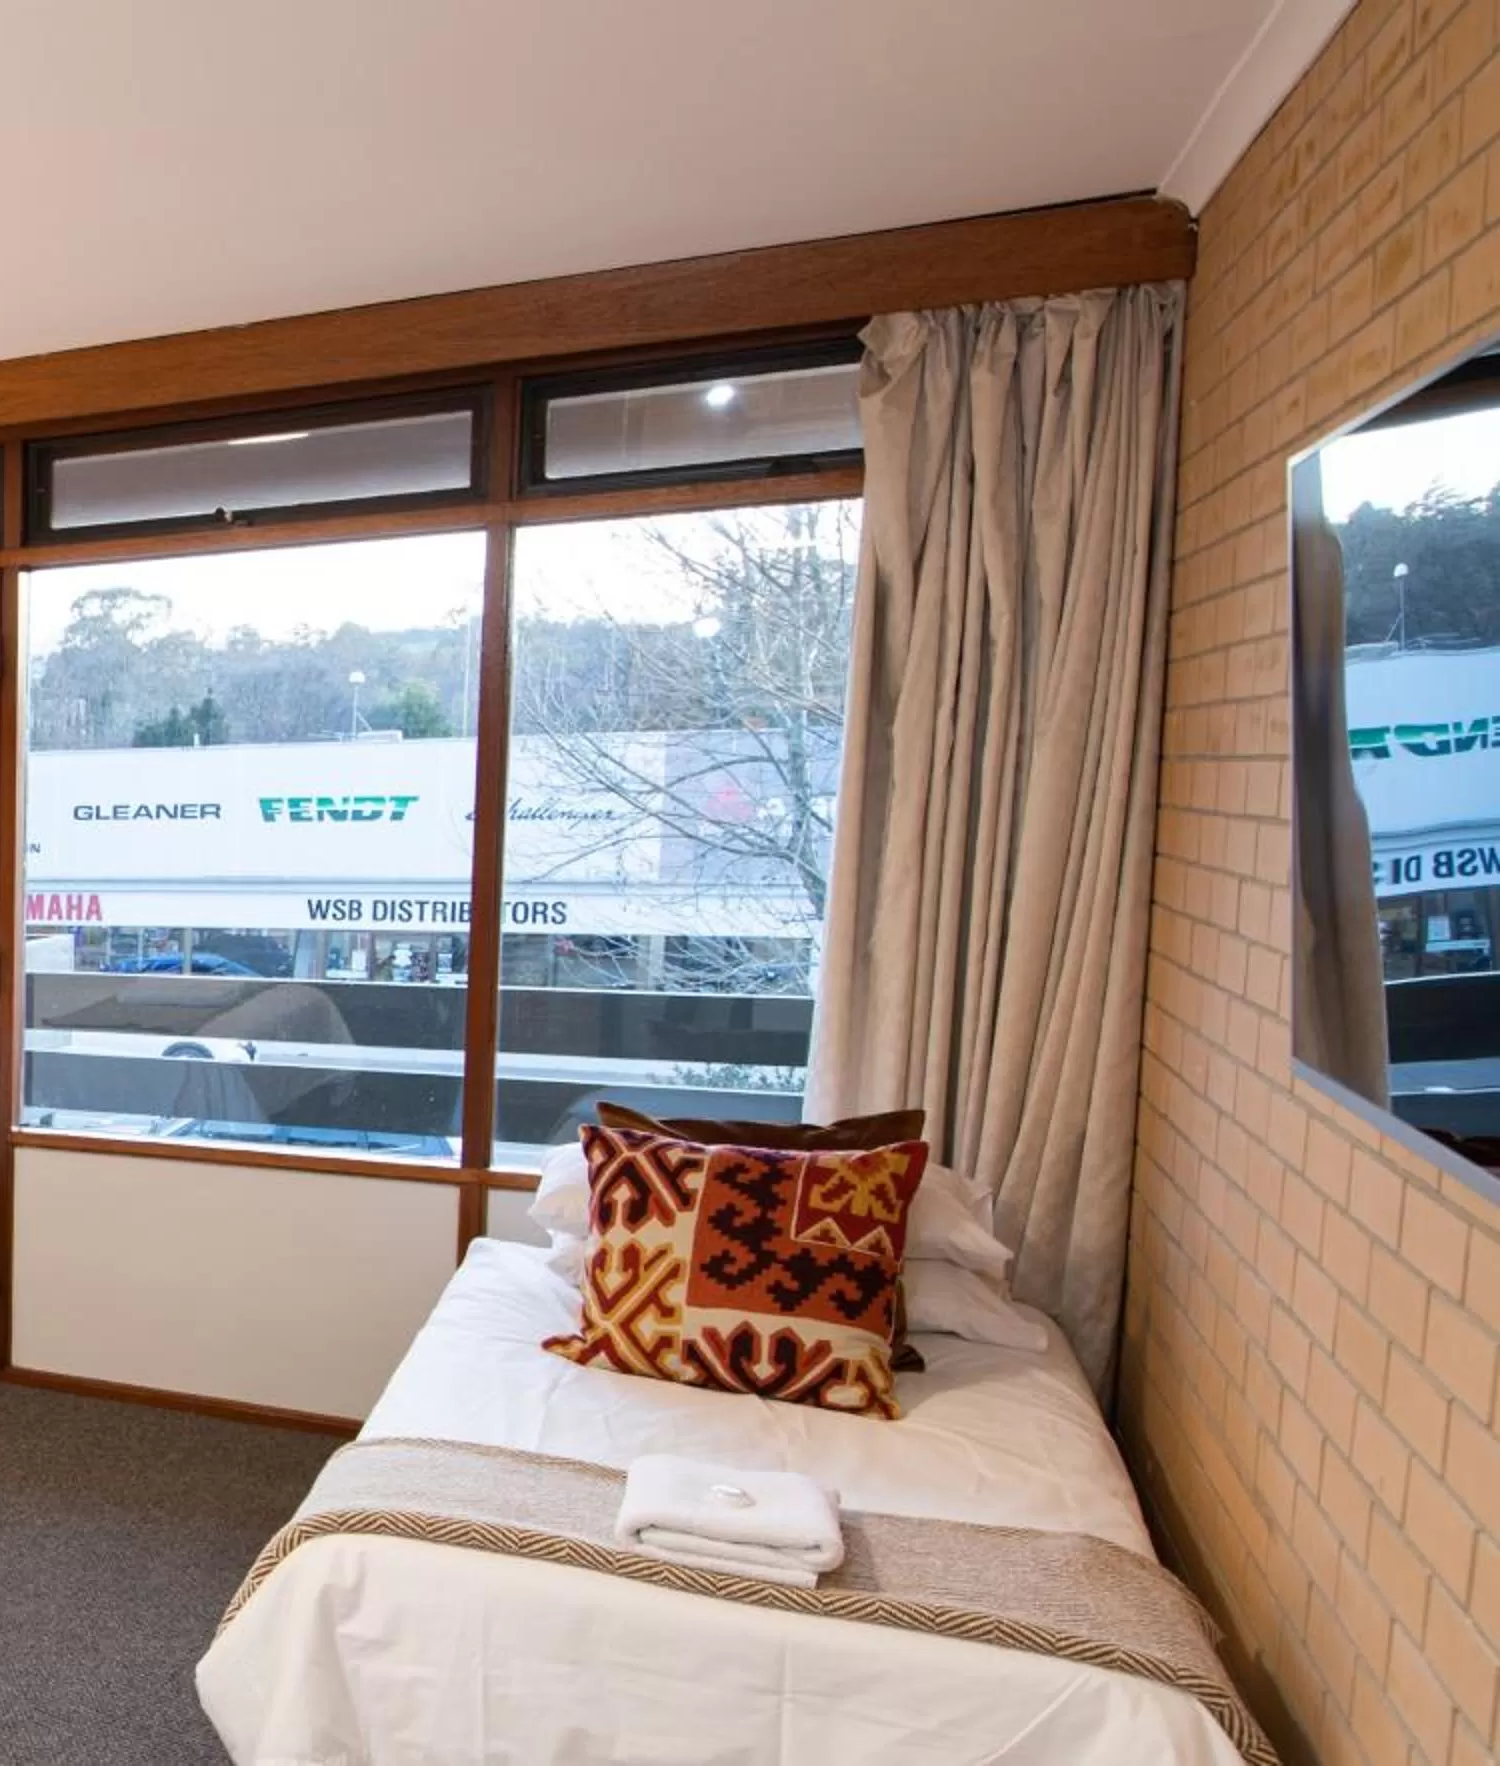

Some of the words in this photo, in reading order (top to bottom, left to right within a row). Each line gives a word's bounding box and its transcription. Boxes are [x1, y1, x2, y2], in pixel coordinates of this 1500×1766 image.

[73, 803, 222, 821] GLEANER
[258, 795, 420, 822] FENDT
[465, 797, 614, 831] hallenger
[26, 894, 102, 921] MAHA
[307, 899, 363, 921] WSB
[372, 899, 567, 925] DISTRIBTORS
